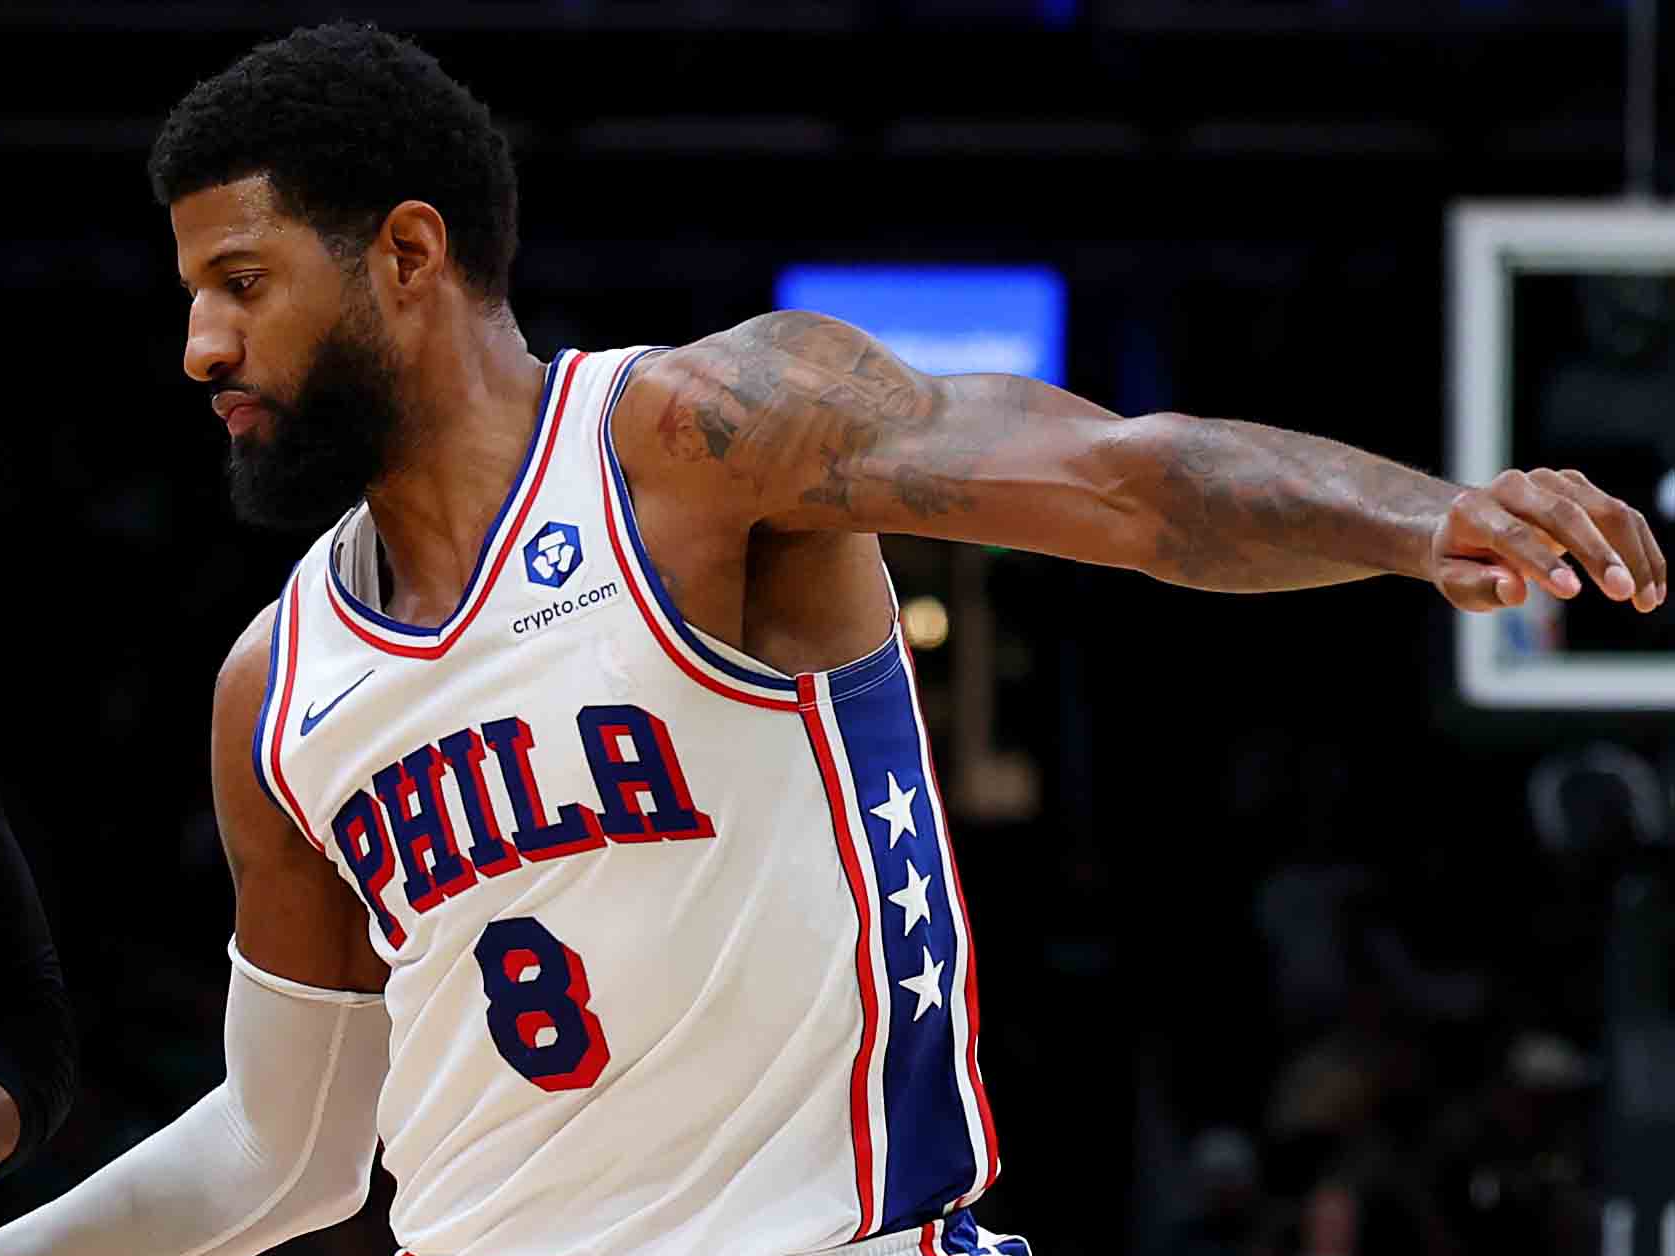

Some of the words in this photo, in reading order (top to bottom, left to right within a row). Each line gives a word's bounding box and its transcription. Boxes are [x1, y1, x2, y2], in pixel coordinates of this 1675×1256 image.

[513, 579, 618, 634] crypto.com
[331, 704, 716, 950] PHILA
[474, 916, 610, 1091] 8
